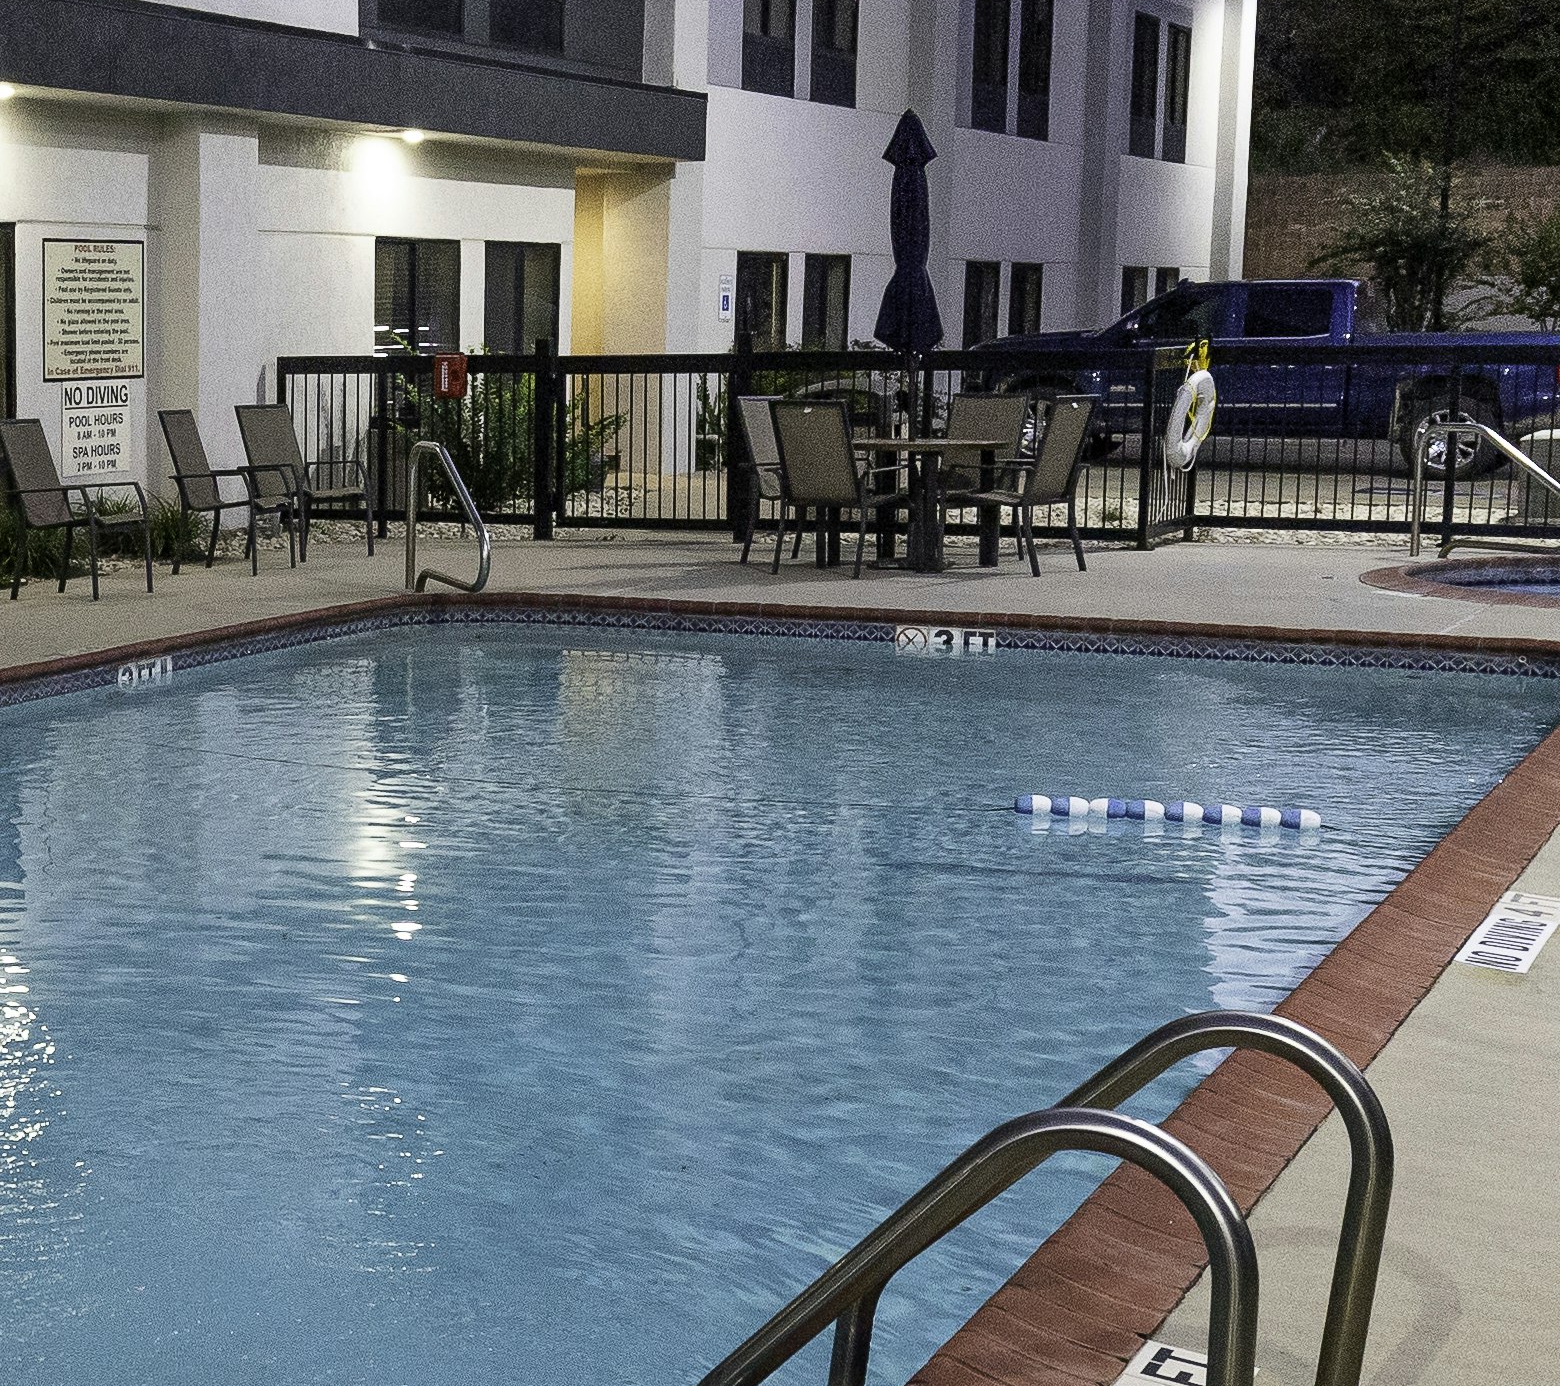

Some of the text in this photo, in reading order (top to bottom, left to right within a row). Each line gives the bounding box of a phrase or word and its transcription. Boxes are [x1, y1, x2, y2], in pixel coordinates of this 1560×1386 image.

[74, 245, 92, 253] POOL
[55, 367, 70, 375] Case
[72, 366, 79, 374] of
[80, 366, 113, 375] Emergency
[64, 385, 128, 406] NO DIVING
[69, 413, 123, 428] POOL HOURS
[82, 430, 92, 440] AM
[106, 428, 116, 438] PM
[72, 443, 121, 459] SPA HOURS
[82, 461, 92, 471] PM
[106, 459, 117, 469] PM
[963, 630, 995, 649] FT
[1504, 906, 1554, 917] 4
[1465, 917, 1547, 970] NO DIVING
